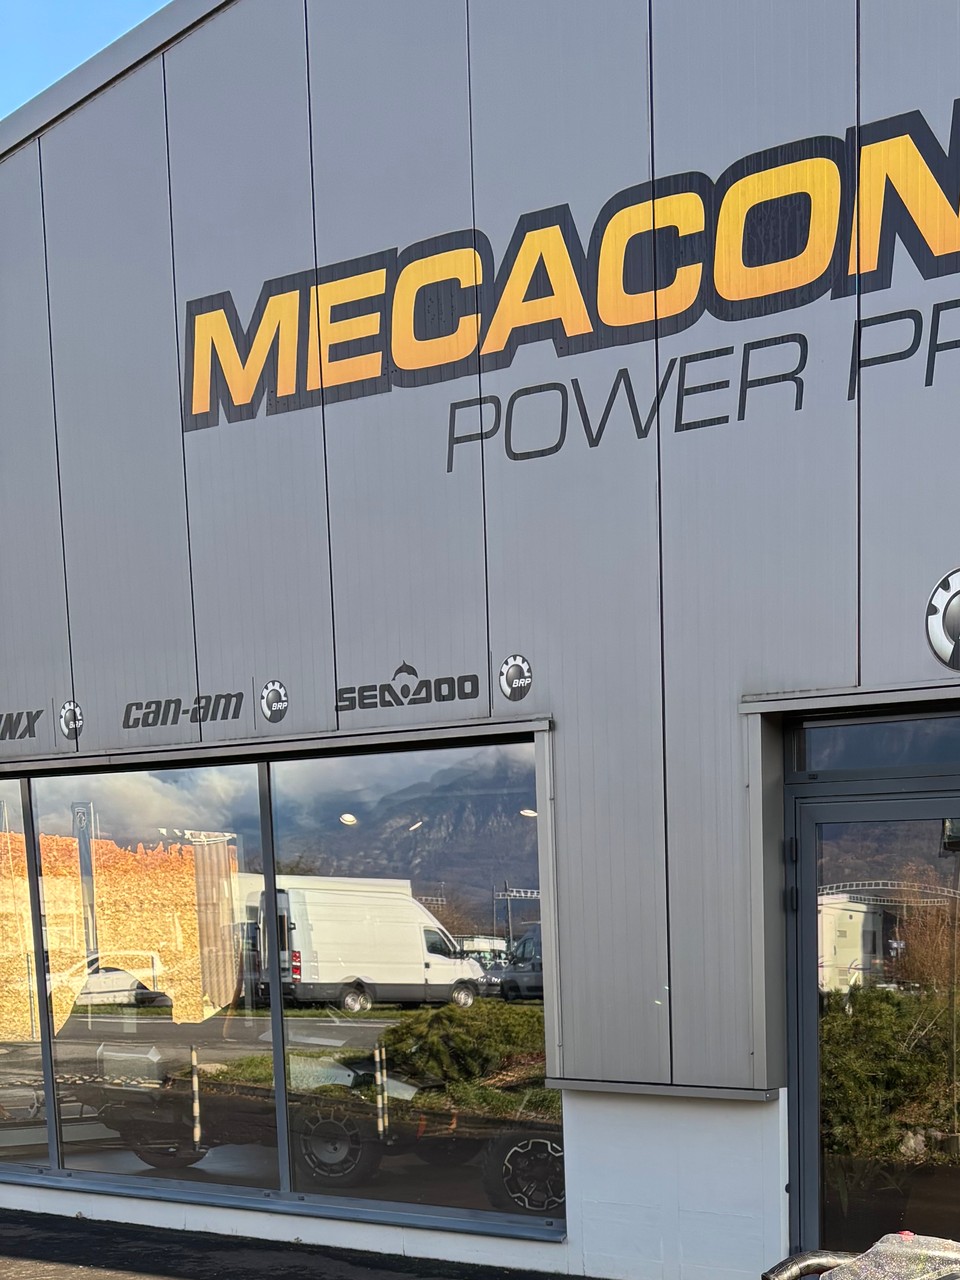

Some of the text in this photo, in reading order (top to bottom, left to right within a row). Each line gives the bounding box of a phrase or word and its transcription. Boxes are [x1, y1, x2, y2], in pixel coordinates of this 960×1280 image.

[446, 332, 808, 473] POWER
[512, 678, 532, 688] BRP
[122, 691, 244, 729] can-am
[272, 702, 288, 711] BRP
[0, 709, 44, 741] NX
[69, 720, 83, 729] BRP
